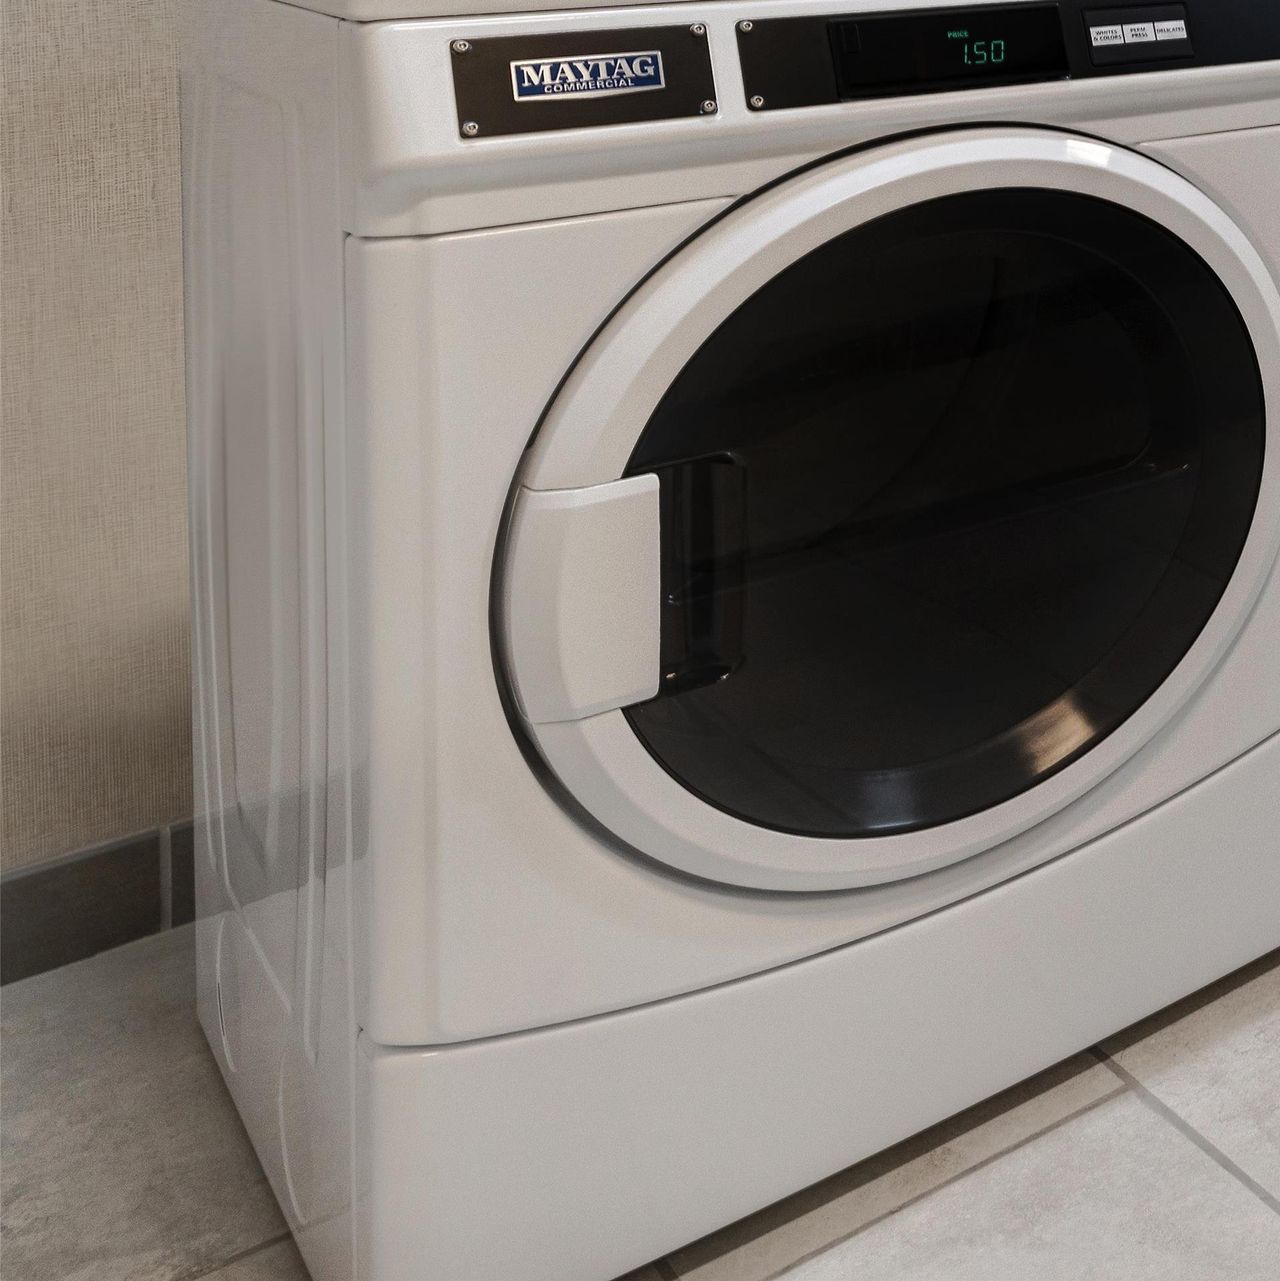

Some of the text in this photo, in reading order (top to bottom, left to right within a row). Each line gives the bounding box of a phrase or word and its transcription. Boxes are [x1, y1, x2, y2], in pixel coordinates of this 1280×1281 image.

[964, 40, 1004, 64] 1.50
[520, 56, 655, 86] MAYTAG
[544, 77, 636, 94] COMMERCIAL
